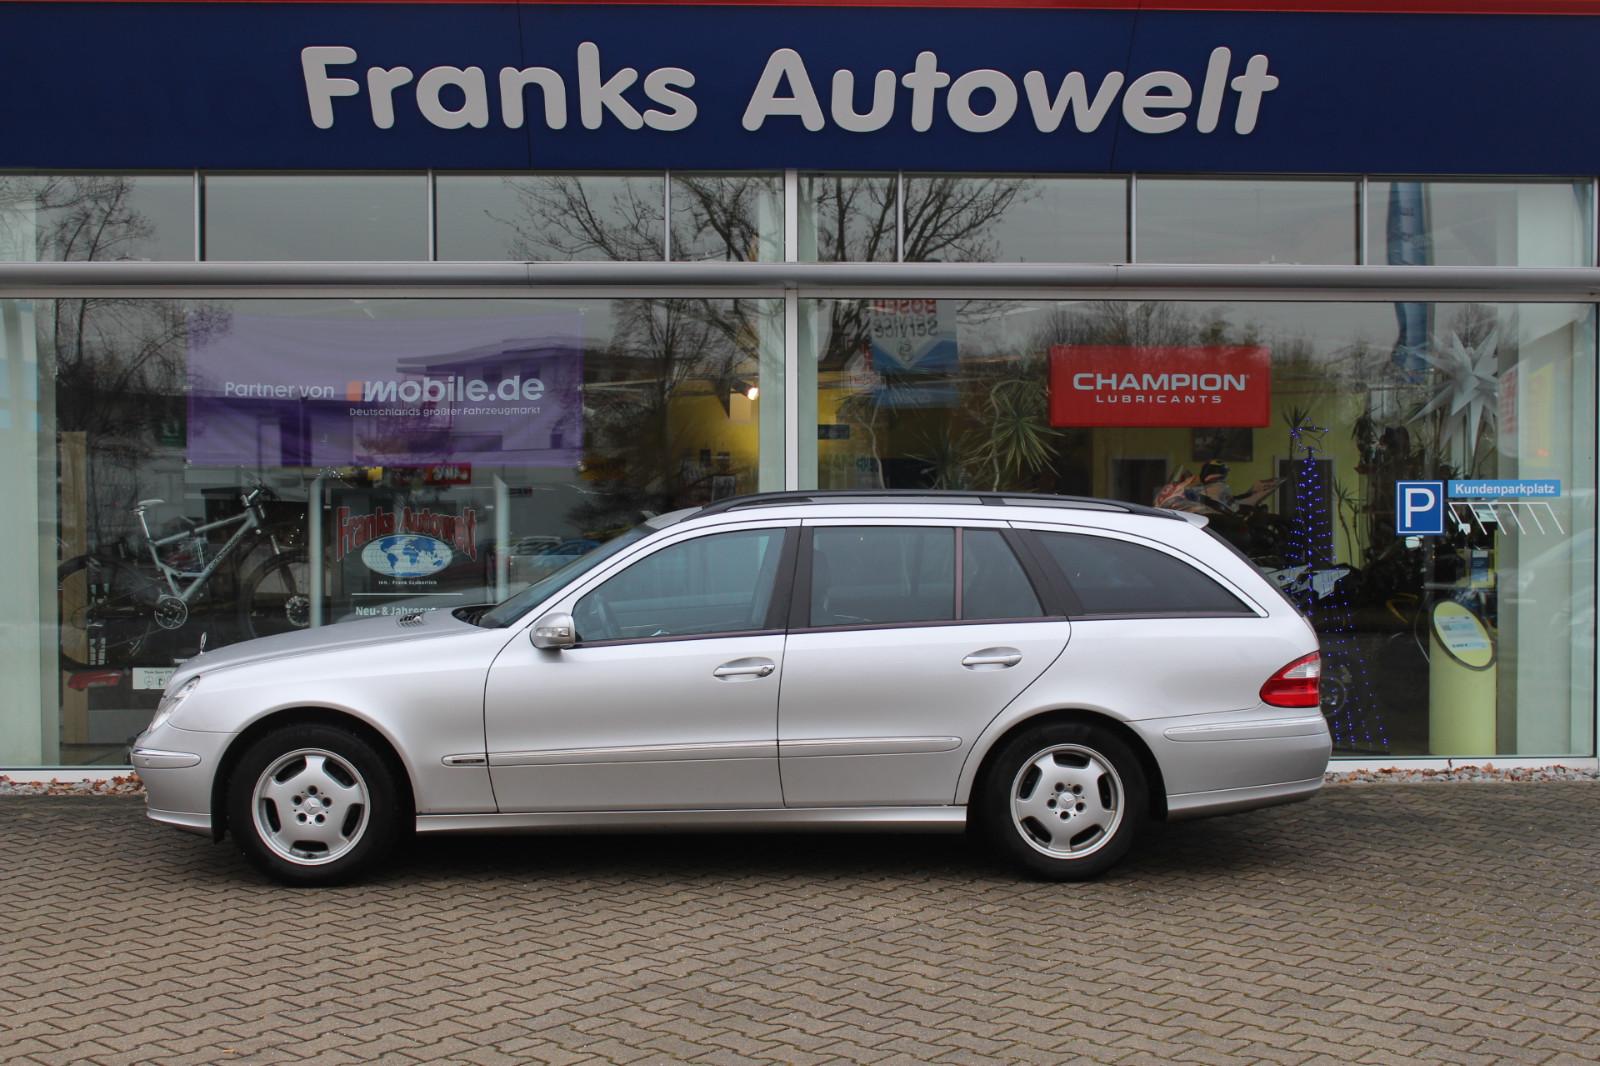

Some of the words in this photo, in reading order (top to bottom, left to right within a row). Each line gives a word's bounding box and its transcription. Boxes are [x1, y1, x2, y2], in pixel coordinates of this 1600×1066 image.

[301, 42, 698, 132] Franks
[742, 47, 1279, 135] Autowelt
[225, 382, 295, 398] Partner
[300, 385, 335, 398] von
[364, 375, 545, 402] mobile.de
[1073, 373, 1246, 391] CHAMPION
[1096, 395, 1222, 404] LUBRICANTS
[349, 407, 421, 417] Deutschlands
[463, 407, 541, 417] Fahrzeugmarkt
[1455, 483, 1556, 497] Kundenparkplatz
[1405, 487, 1436, 528] P
[336, 506, 397, 562] Franks
[399, 506, 478, 562] Autowelt
[355, 606, 380, 616] Neu-
